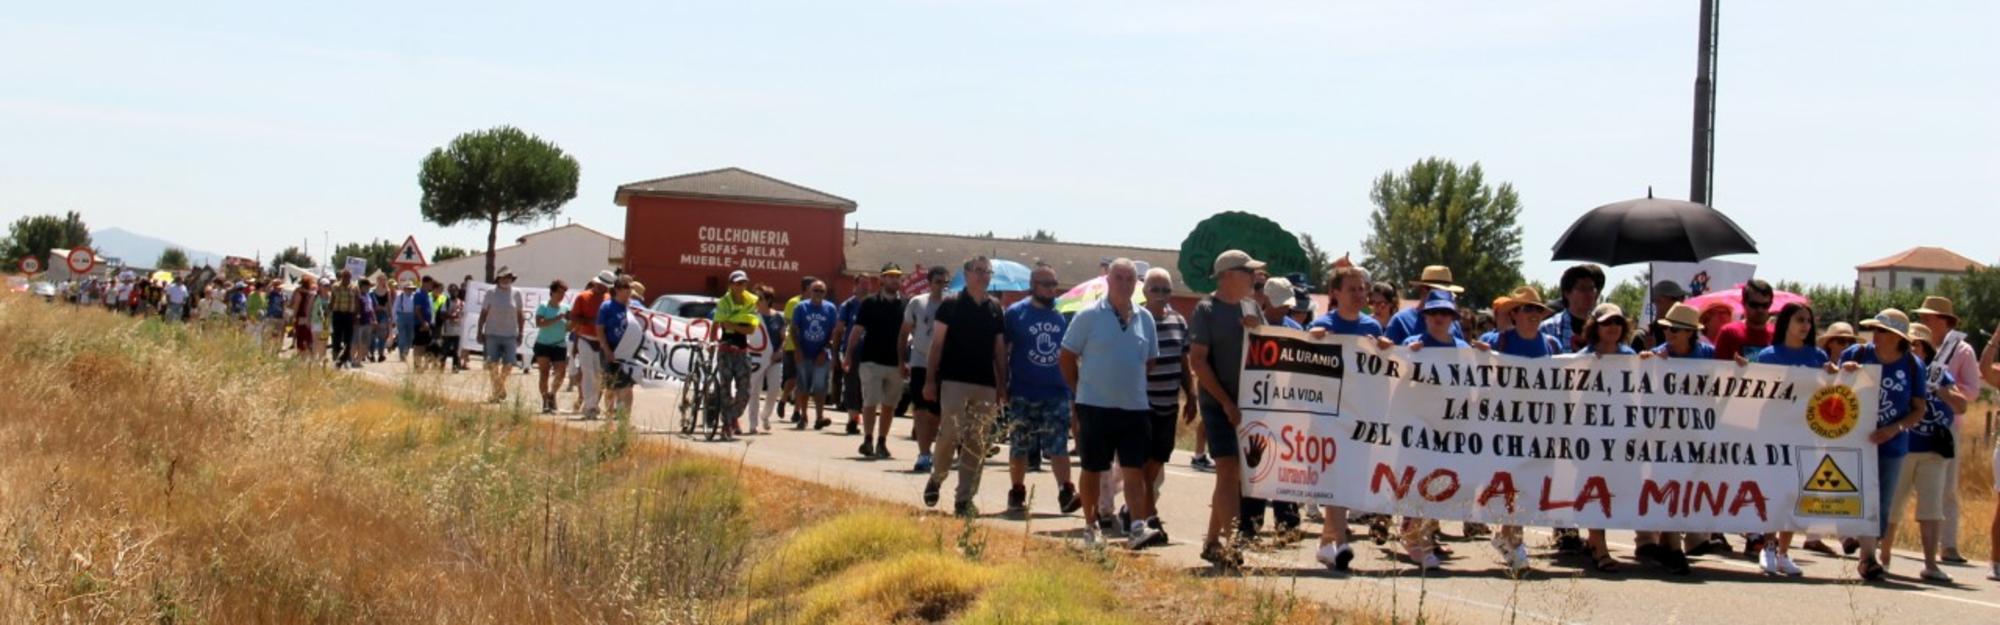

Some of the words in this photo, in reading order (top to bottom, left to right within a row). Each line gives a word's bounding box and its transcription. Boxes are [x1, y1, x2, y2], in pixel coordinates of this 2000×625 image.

[699, 226, 790, 245] COLCHONERIA
[1029, 322, 1060, 335] STOP
[1246, 338, 1278, 366] NO
[1280, 348, 1294, 362] AL
[1296, 350, 1339, 368] URANIO
[1252, 374, 1270, 405] SÍ
[1273, 389, 1280, 399] A
[1282, 388, 1294, 400] LA
[1297, 389, 1324, 403] VIDA
[1356, 352, 1400, 378] POR
[1410, 362, 1441, 385] LA
[1448, 364, 1611, 396] NATURALEZA,
[1621, 371, 1653, 394] LA
[1442, 399, 1469, 420] LA
[1478, 399, 1555, 424] SALUD
[1563, 403, 1576, 425] Y
[1584, 403, 1615, 426] EL
[1624, 406, 1716, 430] FUTURO
[1280, 424, 1337, 472] Stop
[1350, 420, 1391, 445] DEL
[1401, 425, 1483, 454] CAMPO
[1492, 434, 1590, 460] CHARRO
[1601, 438, 1615, 461] Y
[1625, 439, 1756, 466] SALAMANCA
[1765, 444, 1792, 466] DI
[1278, 465, 1319, 486] uranio
[1370, 462, 1460, 502] NO
[1477, 471, 1520, 513] A
[1539, 475, 1615, 518] LA
[1638, 479, 1769, 522] MINA
